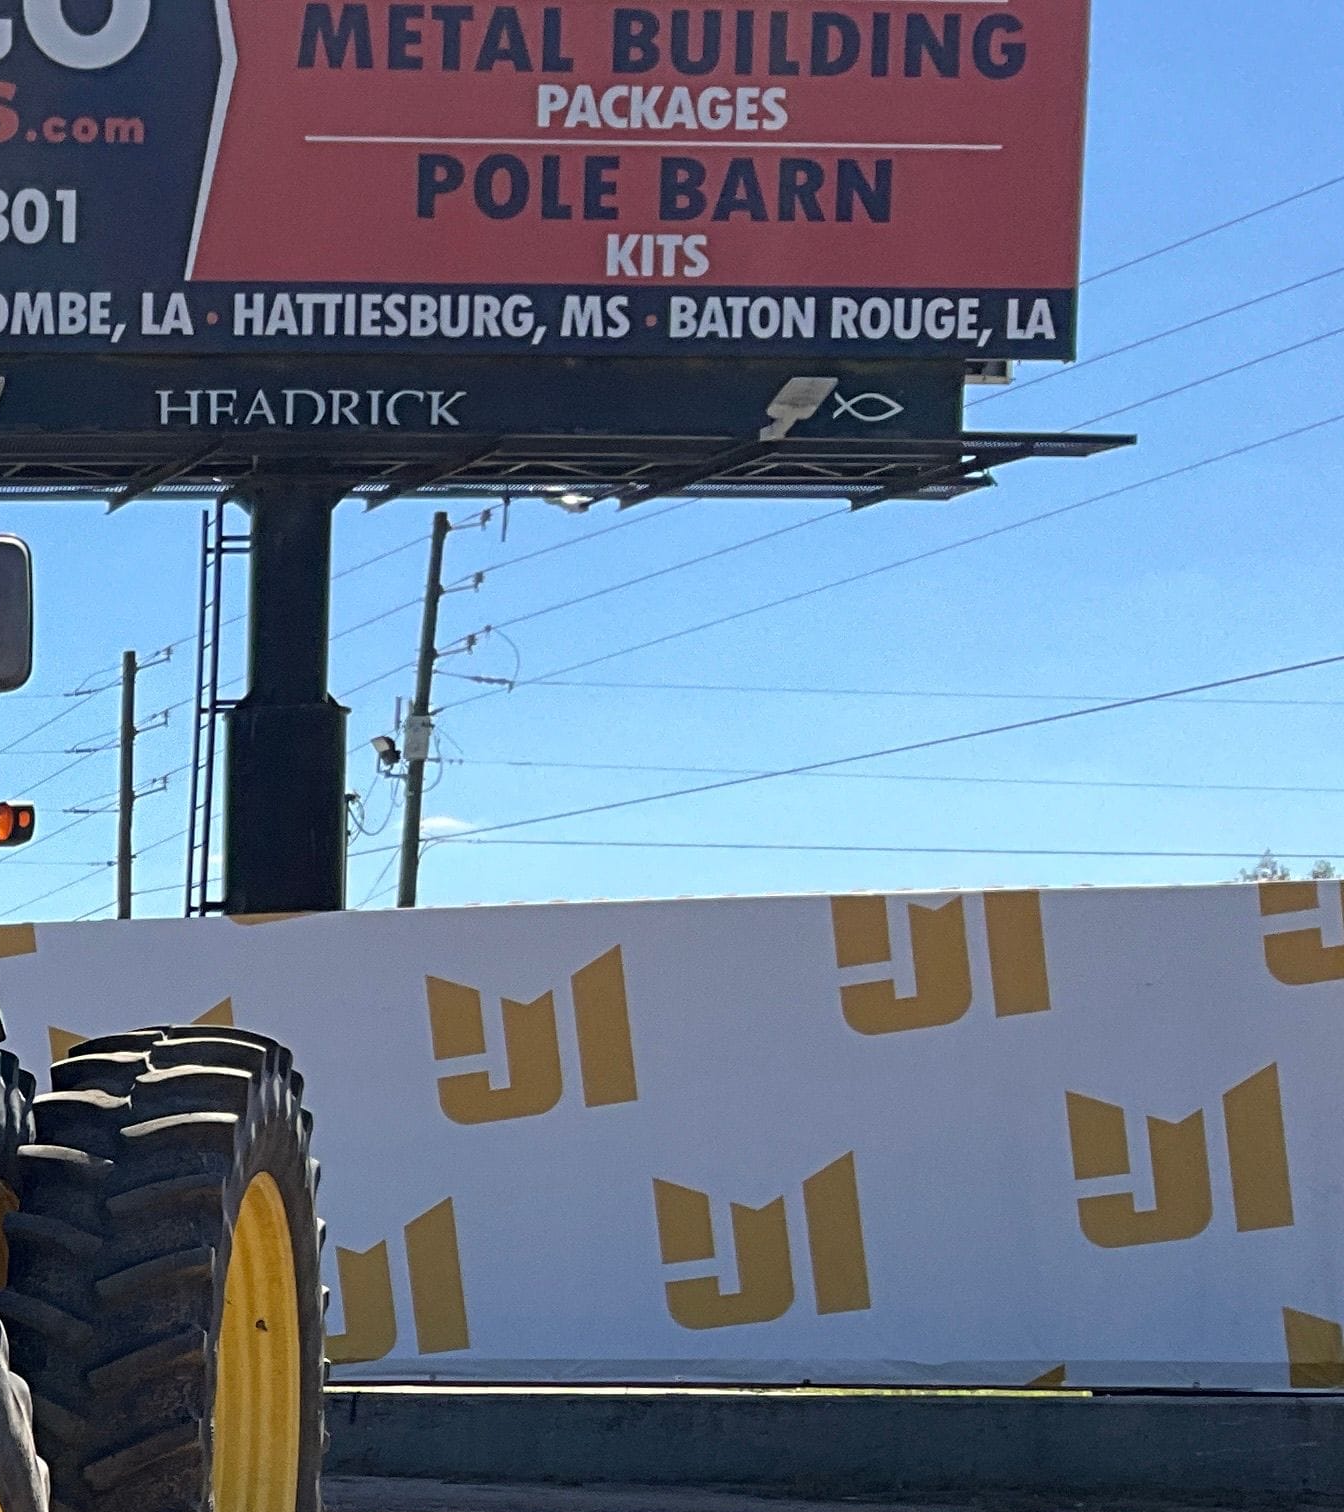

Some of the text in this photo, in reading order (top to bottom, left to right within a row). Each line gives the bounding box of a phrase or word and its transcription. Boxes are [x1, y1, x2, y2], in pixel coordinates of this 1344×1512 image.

[297, 3, 1028, 80] METAL BUILDING
[536, 84, 789, 132] PACKAGES
[416, 153, 894, 225] POLE BARN
[605, 234, 711, 278] KITS
[140, 292, 195, 336] LA
[232, 293, 548, 345] HATTIESBURG,
[560, 295, 631, 338] MS
[669, 297, 817, 341] BATON
[830, 298, 994, 348] ROUGE,
[1005, 299, 1057, 342] LA
[154, 389, 468, 426] HEADRICK
